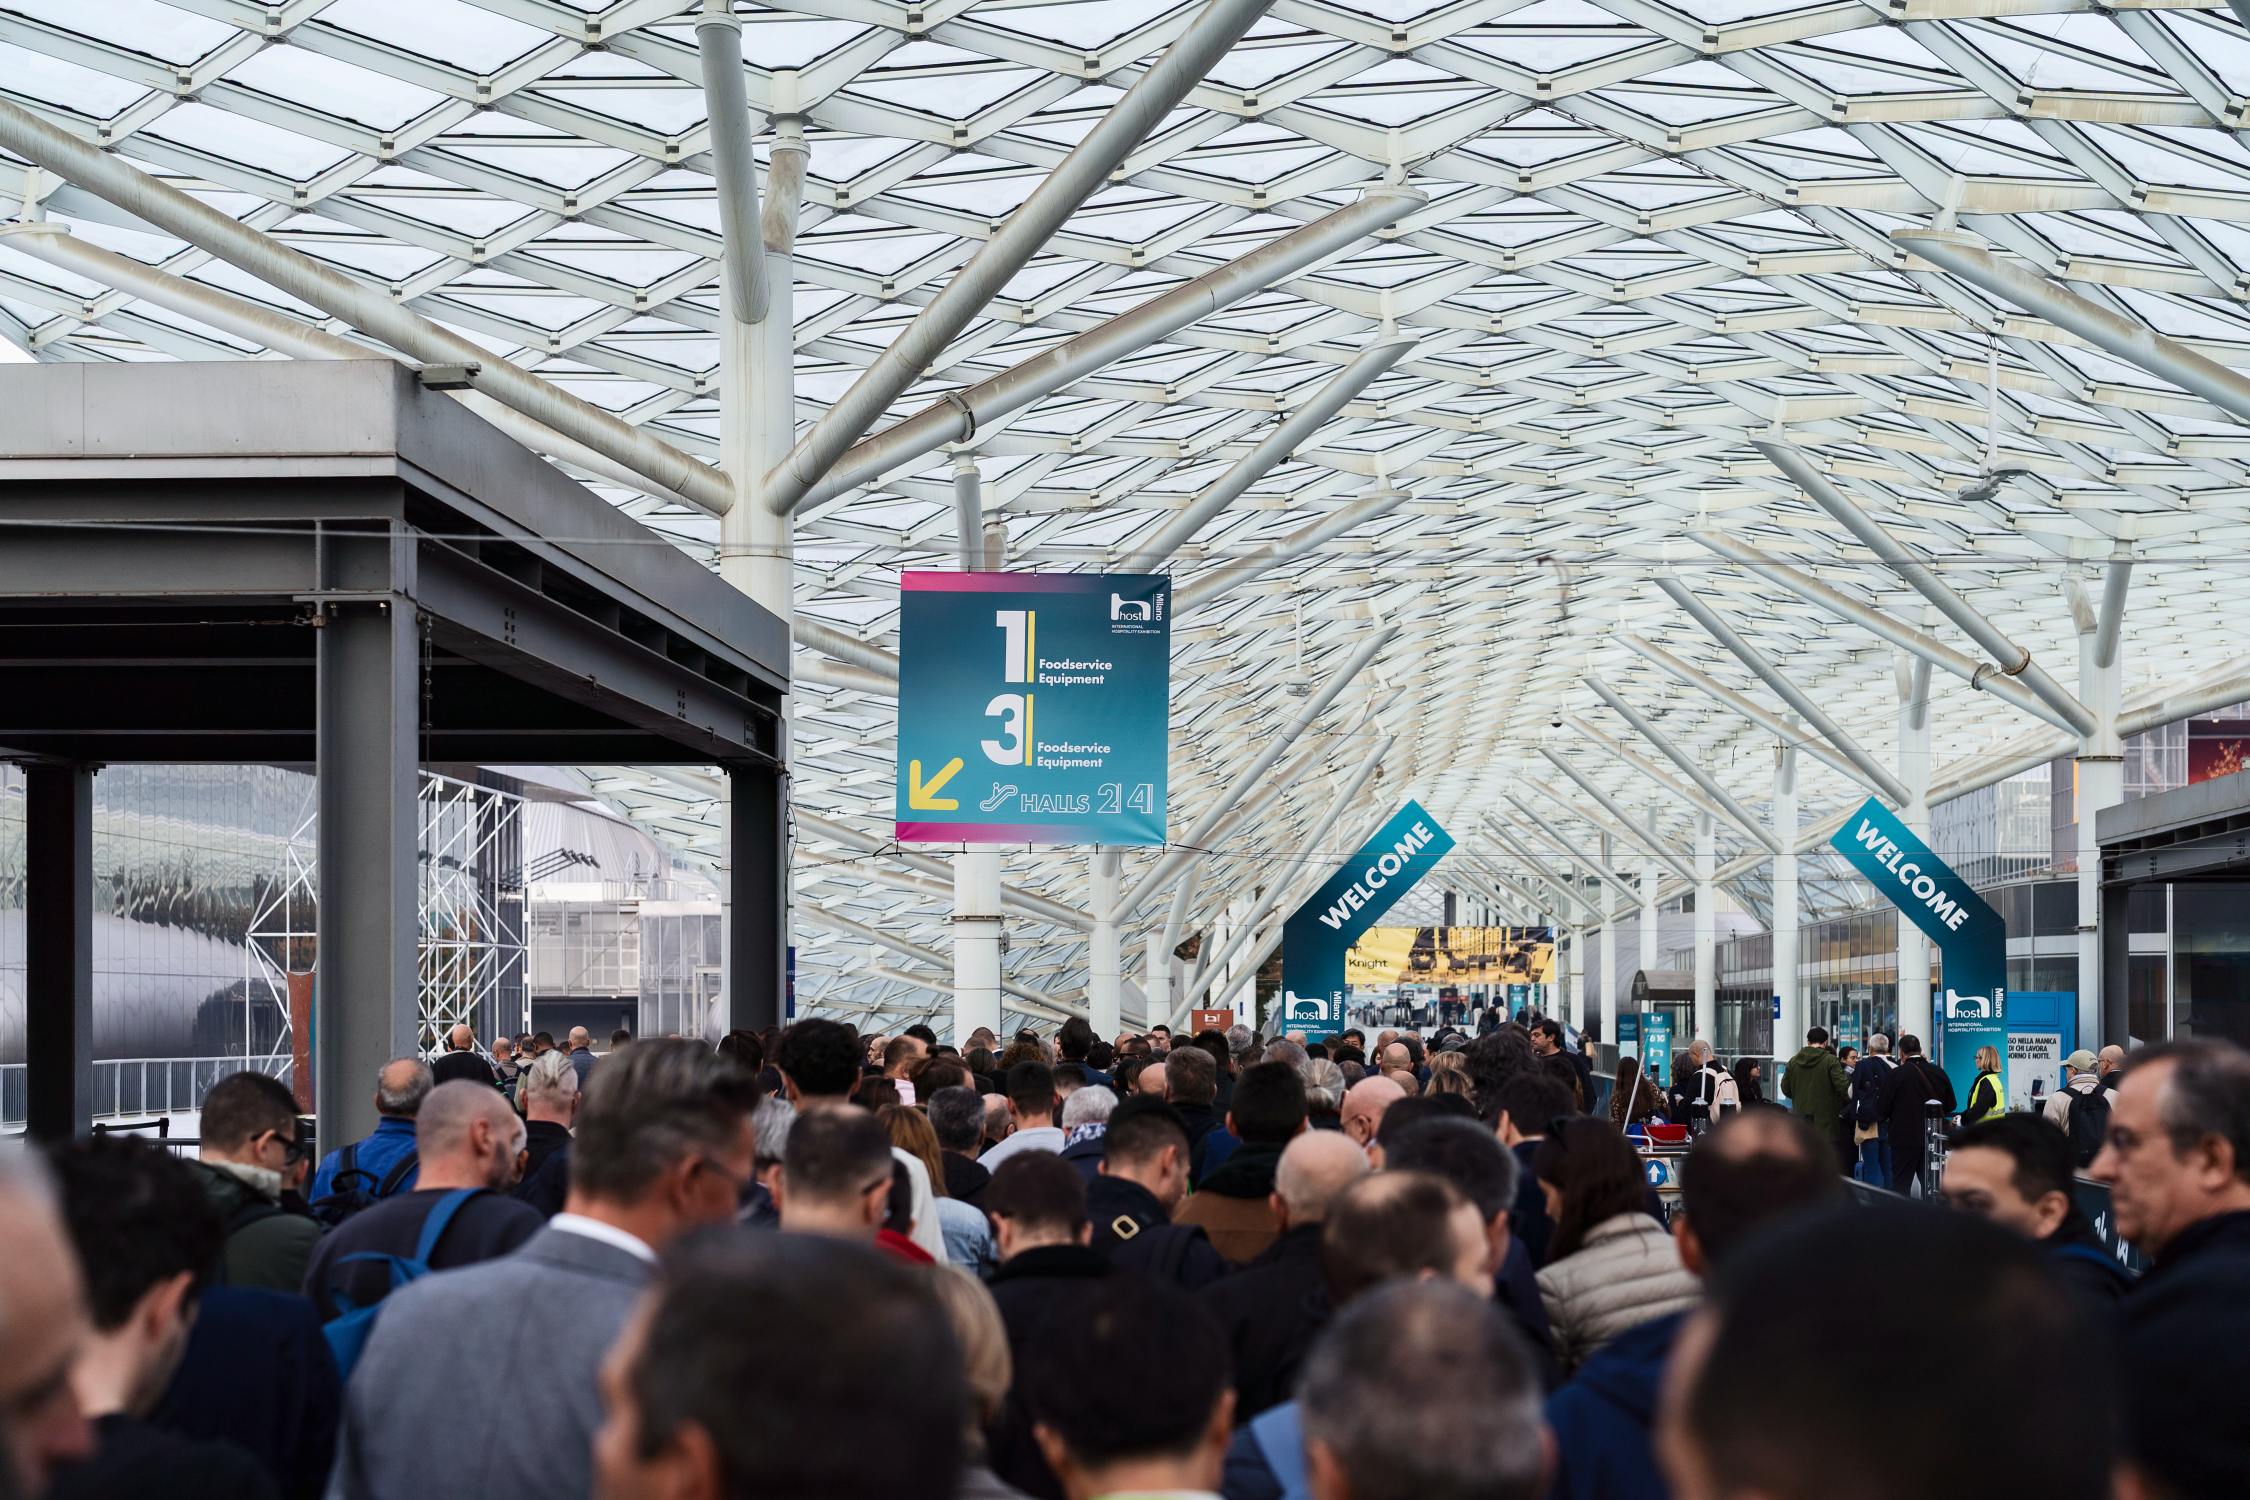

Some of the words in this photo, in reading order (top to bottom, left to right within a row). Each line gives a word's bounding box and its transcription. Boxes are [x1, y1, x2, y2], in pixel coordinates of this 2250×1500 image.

[1155, 593, 1165, 621] Milano
[1119, 611, 1143, 621] host
[996, 611, 1026, 682] 1
[1039, 658, 1112, 671] Foodservice
[1039, 673, 1104, 686] Equipment
[980, 693, 1025, 766] 3
[1037, 741, 1111, 754] Foodservice
[1037, 756, 1103, 770] Equipment
[1020, 793, 1090, 814] HALLS
[1319, 821, 1434, 930] WELCOME
[1855, 818, 1969, 931] WELCOME
[1348, 959, 1389, 970] Knight
[1332, 991, 1342, 1020] Milano
[1994, 987, 2004, 1018] Milano
[1294, 1010, 1319, 1020] host
[1956, 1008, 1981, 1019] host
